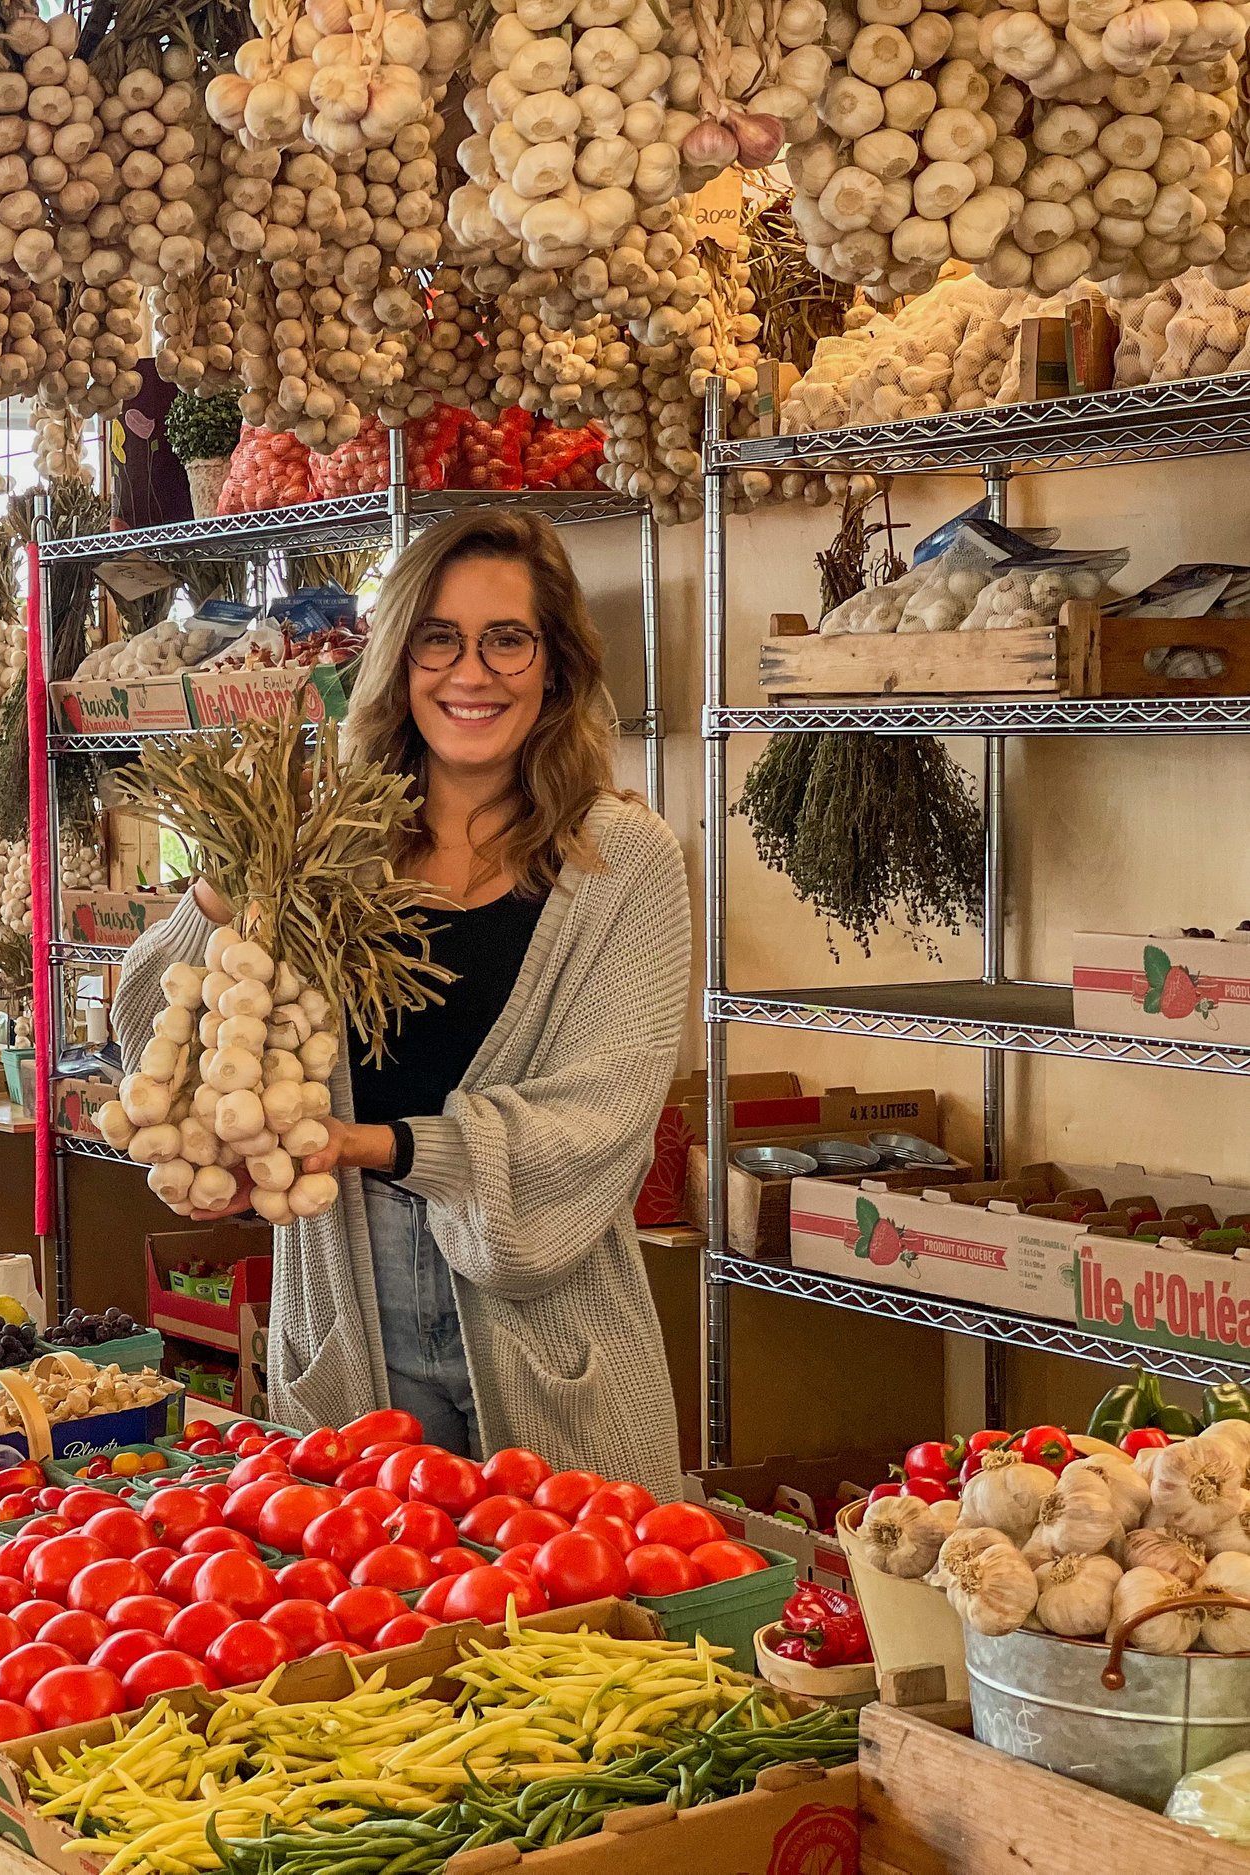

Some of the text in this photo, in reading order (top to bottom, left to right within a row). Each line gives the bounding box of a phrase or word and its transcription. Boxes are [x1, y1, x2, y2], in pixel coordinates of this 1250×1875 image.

[76, 691, 120, 718] Fraises
[91, 901, 135, 930] Fraises
[850, 1106, 857, 1120] 4
[871, 1105, 878, 1119] 3
[879, 1102, 919, 1120] LITRES
[923, 1238, 998, 1264] PRODUIT DU QUÉBEC
[1080, 1245, 1250, 1348] Île d'Orléa
